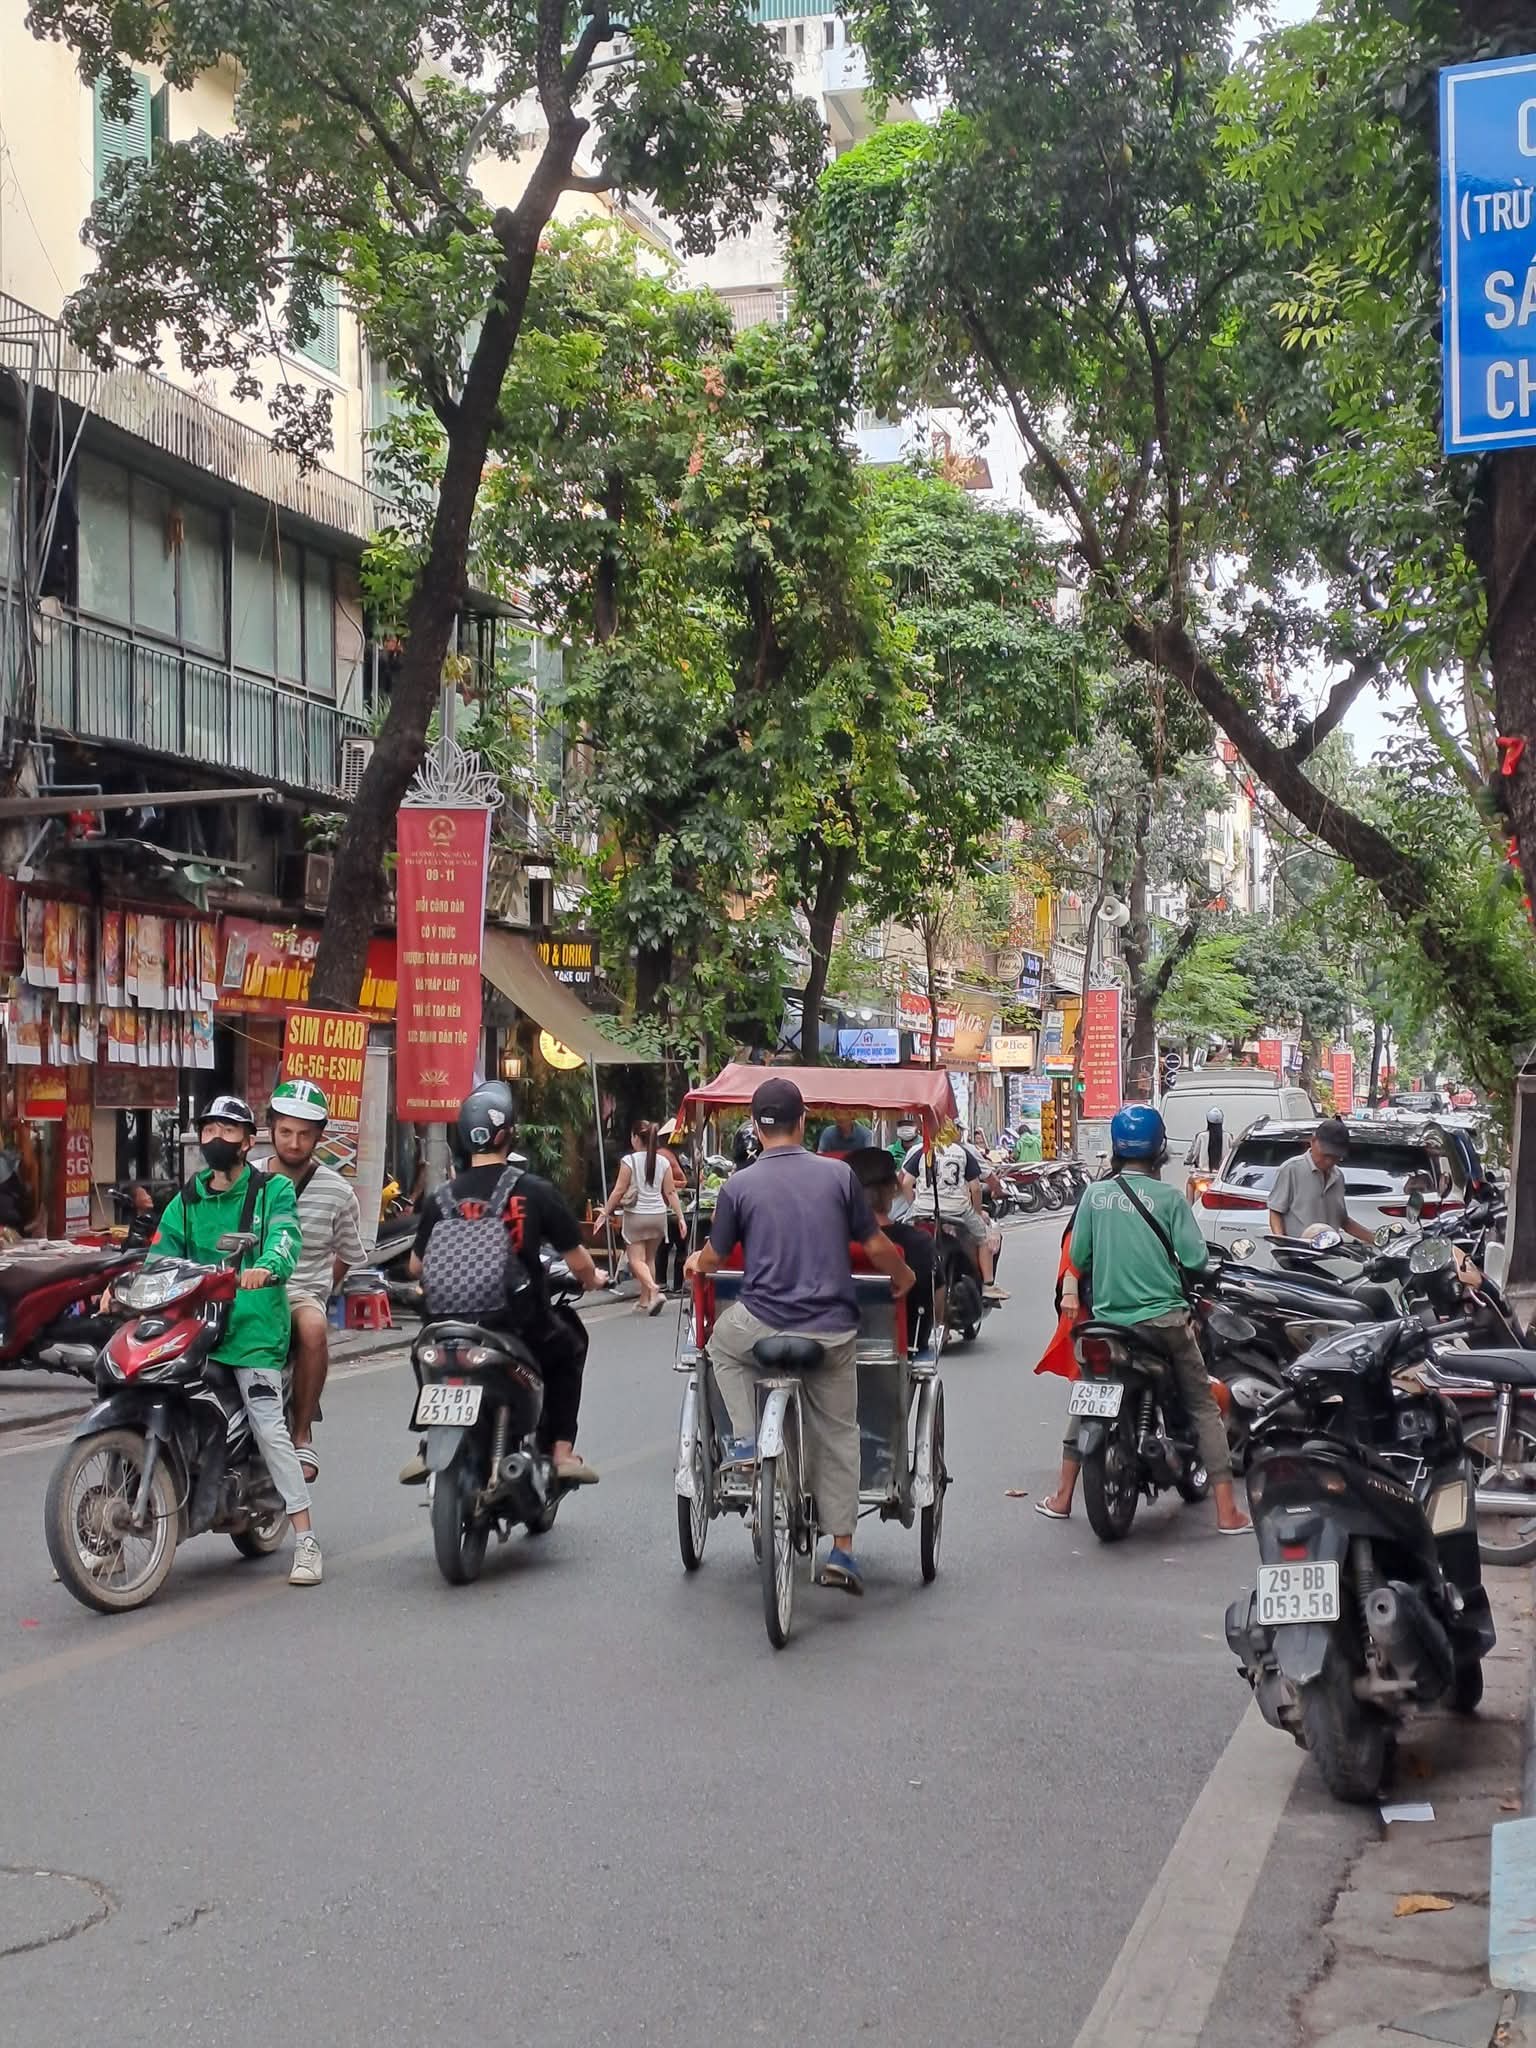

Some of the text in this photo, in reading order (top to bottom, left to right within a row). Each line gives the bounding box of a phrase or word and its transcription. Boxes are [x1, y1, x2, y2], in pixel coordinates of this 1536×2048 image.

[562, 943, 592, 967] DRINK
[575, 972, 591, 983] OUT
[289, 1015, 365, 1050] SIM CARD
[286, 1052, 362, 1082] 4G-5G-ESIM
[66, 1157, 89, 1176] 5G
[1091, 1188, 1155, 1214] Grab
[430, 1388, 471, 1403] 21-B1
[1269, 1566, 1325, 1593] 29-BB
[1263, 1592, 1334, 1619] 053.58
